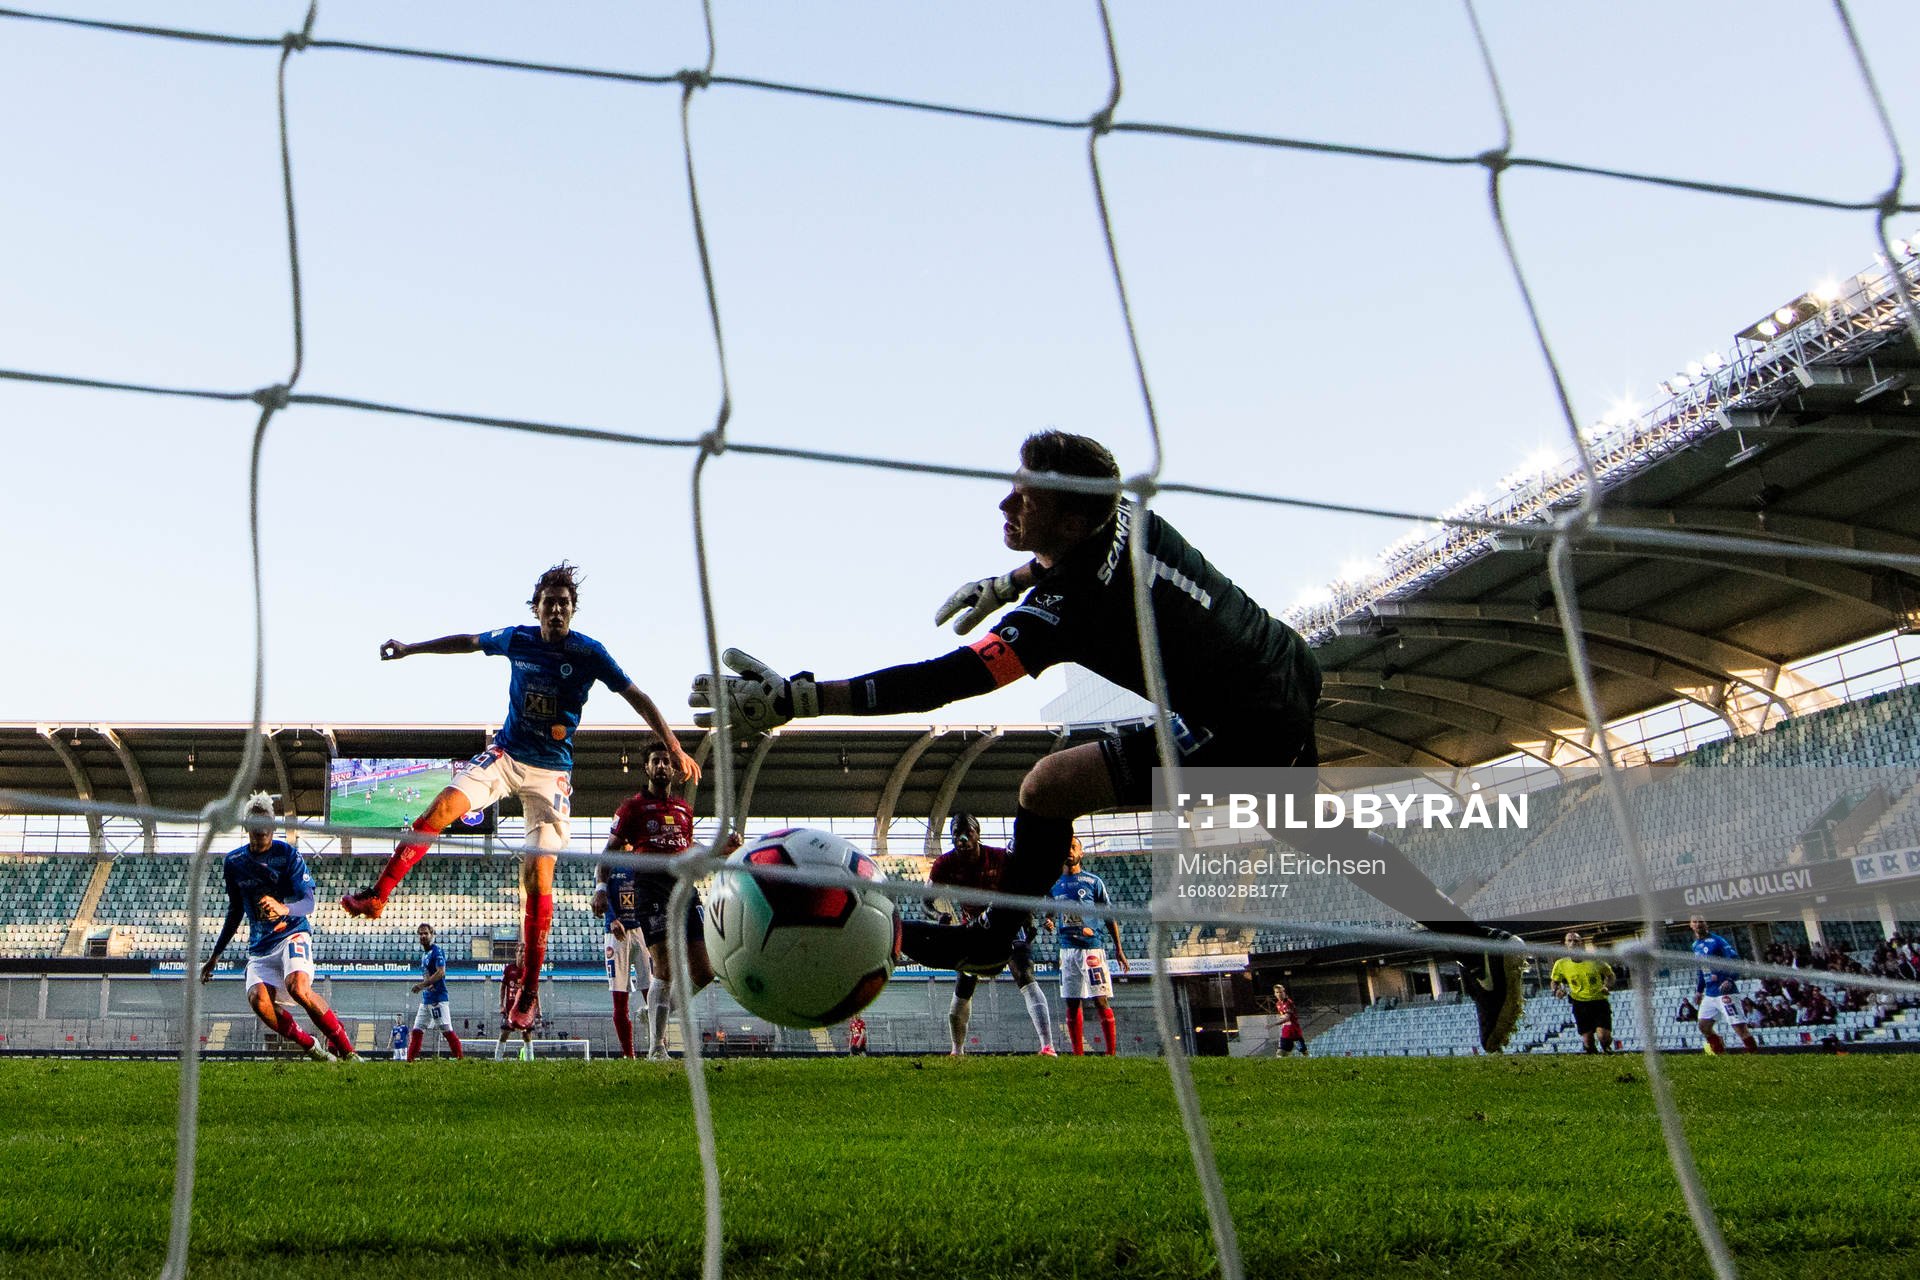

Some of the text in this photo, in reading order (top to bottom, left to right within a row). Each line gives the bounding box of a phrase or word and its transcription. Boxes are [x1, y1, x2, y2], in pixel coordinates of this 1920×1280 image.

[1684, 869, 1812, 907] GAMLA ULLEVI
[355, 963, 384, 972] Gamla
[384, 962, 411, 972] Ullevi
